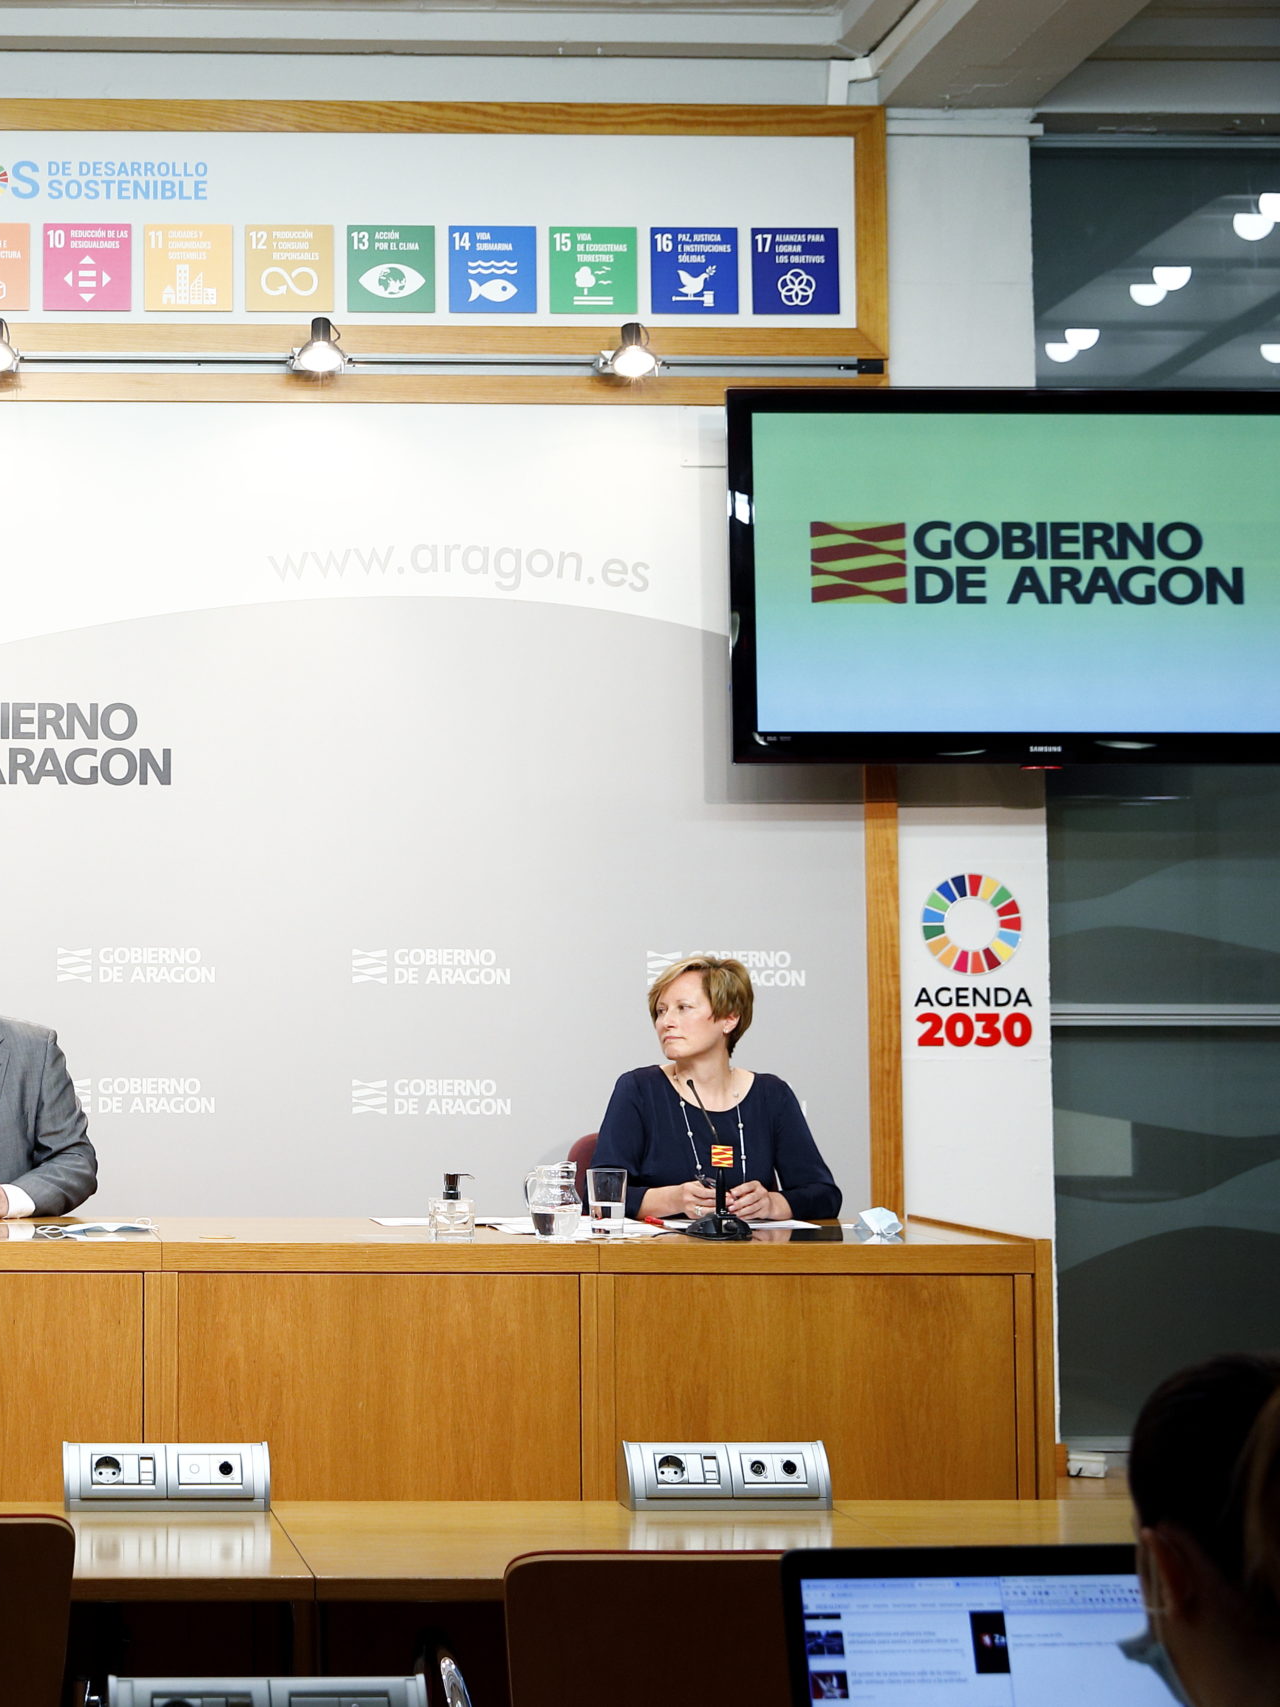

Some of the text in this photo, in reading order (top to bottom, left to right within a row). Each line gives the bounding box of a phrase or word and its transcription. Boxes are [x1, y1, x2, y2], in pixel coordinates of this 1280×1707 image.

[47, 161, 208, 177] DE DESARROLLO
[47, 179, 208, 200] SOSTENIBLE
[47, 230, 65, 248] 10
[71, 228, 128, 238] REDUCCIÓN DE LAS
[148, 231, 163, 249] 11
[249, 231, 267, 249] 12
[272, 230, 313, 239] PRODUCCIÓN
[351, 231, 369, 250] 13
[375, 230, 399, 240] ACCIÓN
[453, 232, 471, 250] 14
[476, 232, 491, 240] VIDA
[577, 233, 591, 241] VIDA
[678, 233, 721, 242] PAZ, JUSTICIA
[776, 234, 824, 242] ALIANZAS PARA
[71, 241, 120, 249] DESIGUALDADES
[278, 242, 309, 250] CONSUMO
[375, 242, 419, 250] POR EL CLIMA
[476, 242, 512, 251] SUBMARINA
[553, 233, 571, 251] 15
[577, 243, 627, 252] DE ECOSISTEMAS
[654, 233, 672, 252] 16
[678, 244, 731, 252] E INSTITUCIONES
[755, 234, 772, 252] 17
[776, 245, 801, 253] LOGRAR
[273, 252, 319, 260] RESPONSABLES
[577, 254, 613, 262] TERRESTRES
[678, 254, 705, 263] SÓLIDAS
[776, 255, 825, 263] LOS OBJETIVOS
[913, 521, 1203, 561] GOBIERNO
[267, 541, 650, 593] www.aragon.es
[914, 566, 1244, 606] DE ARAGON
[1029, 745, 1062, 753] SAMSUNG
[98, 947, 201, 964] GOBIERNO
[394, 948, 496, 966] GOBIERNO
[99, 967, 216, 983] DE ARAGON
[394, 967, 510, 985] DE ARAGON
[914, 987, 1032, 1007] AGENDA
[916, 1012, 1032, 1047] 2030
[98, 1078, 201, 1094] GOBIERNO
[394, 1078, 496, 1097] GOBIERNO
[98, 1097, 216, 1113] DE ARAGON
[394, 1098, 511, 1116] DE ARAGON
